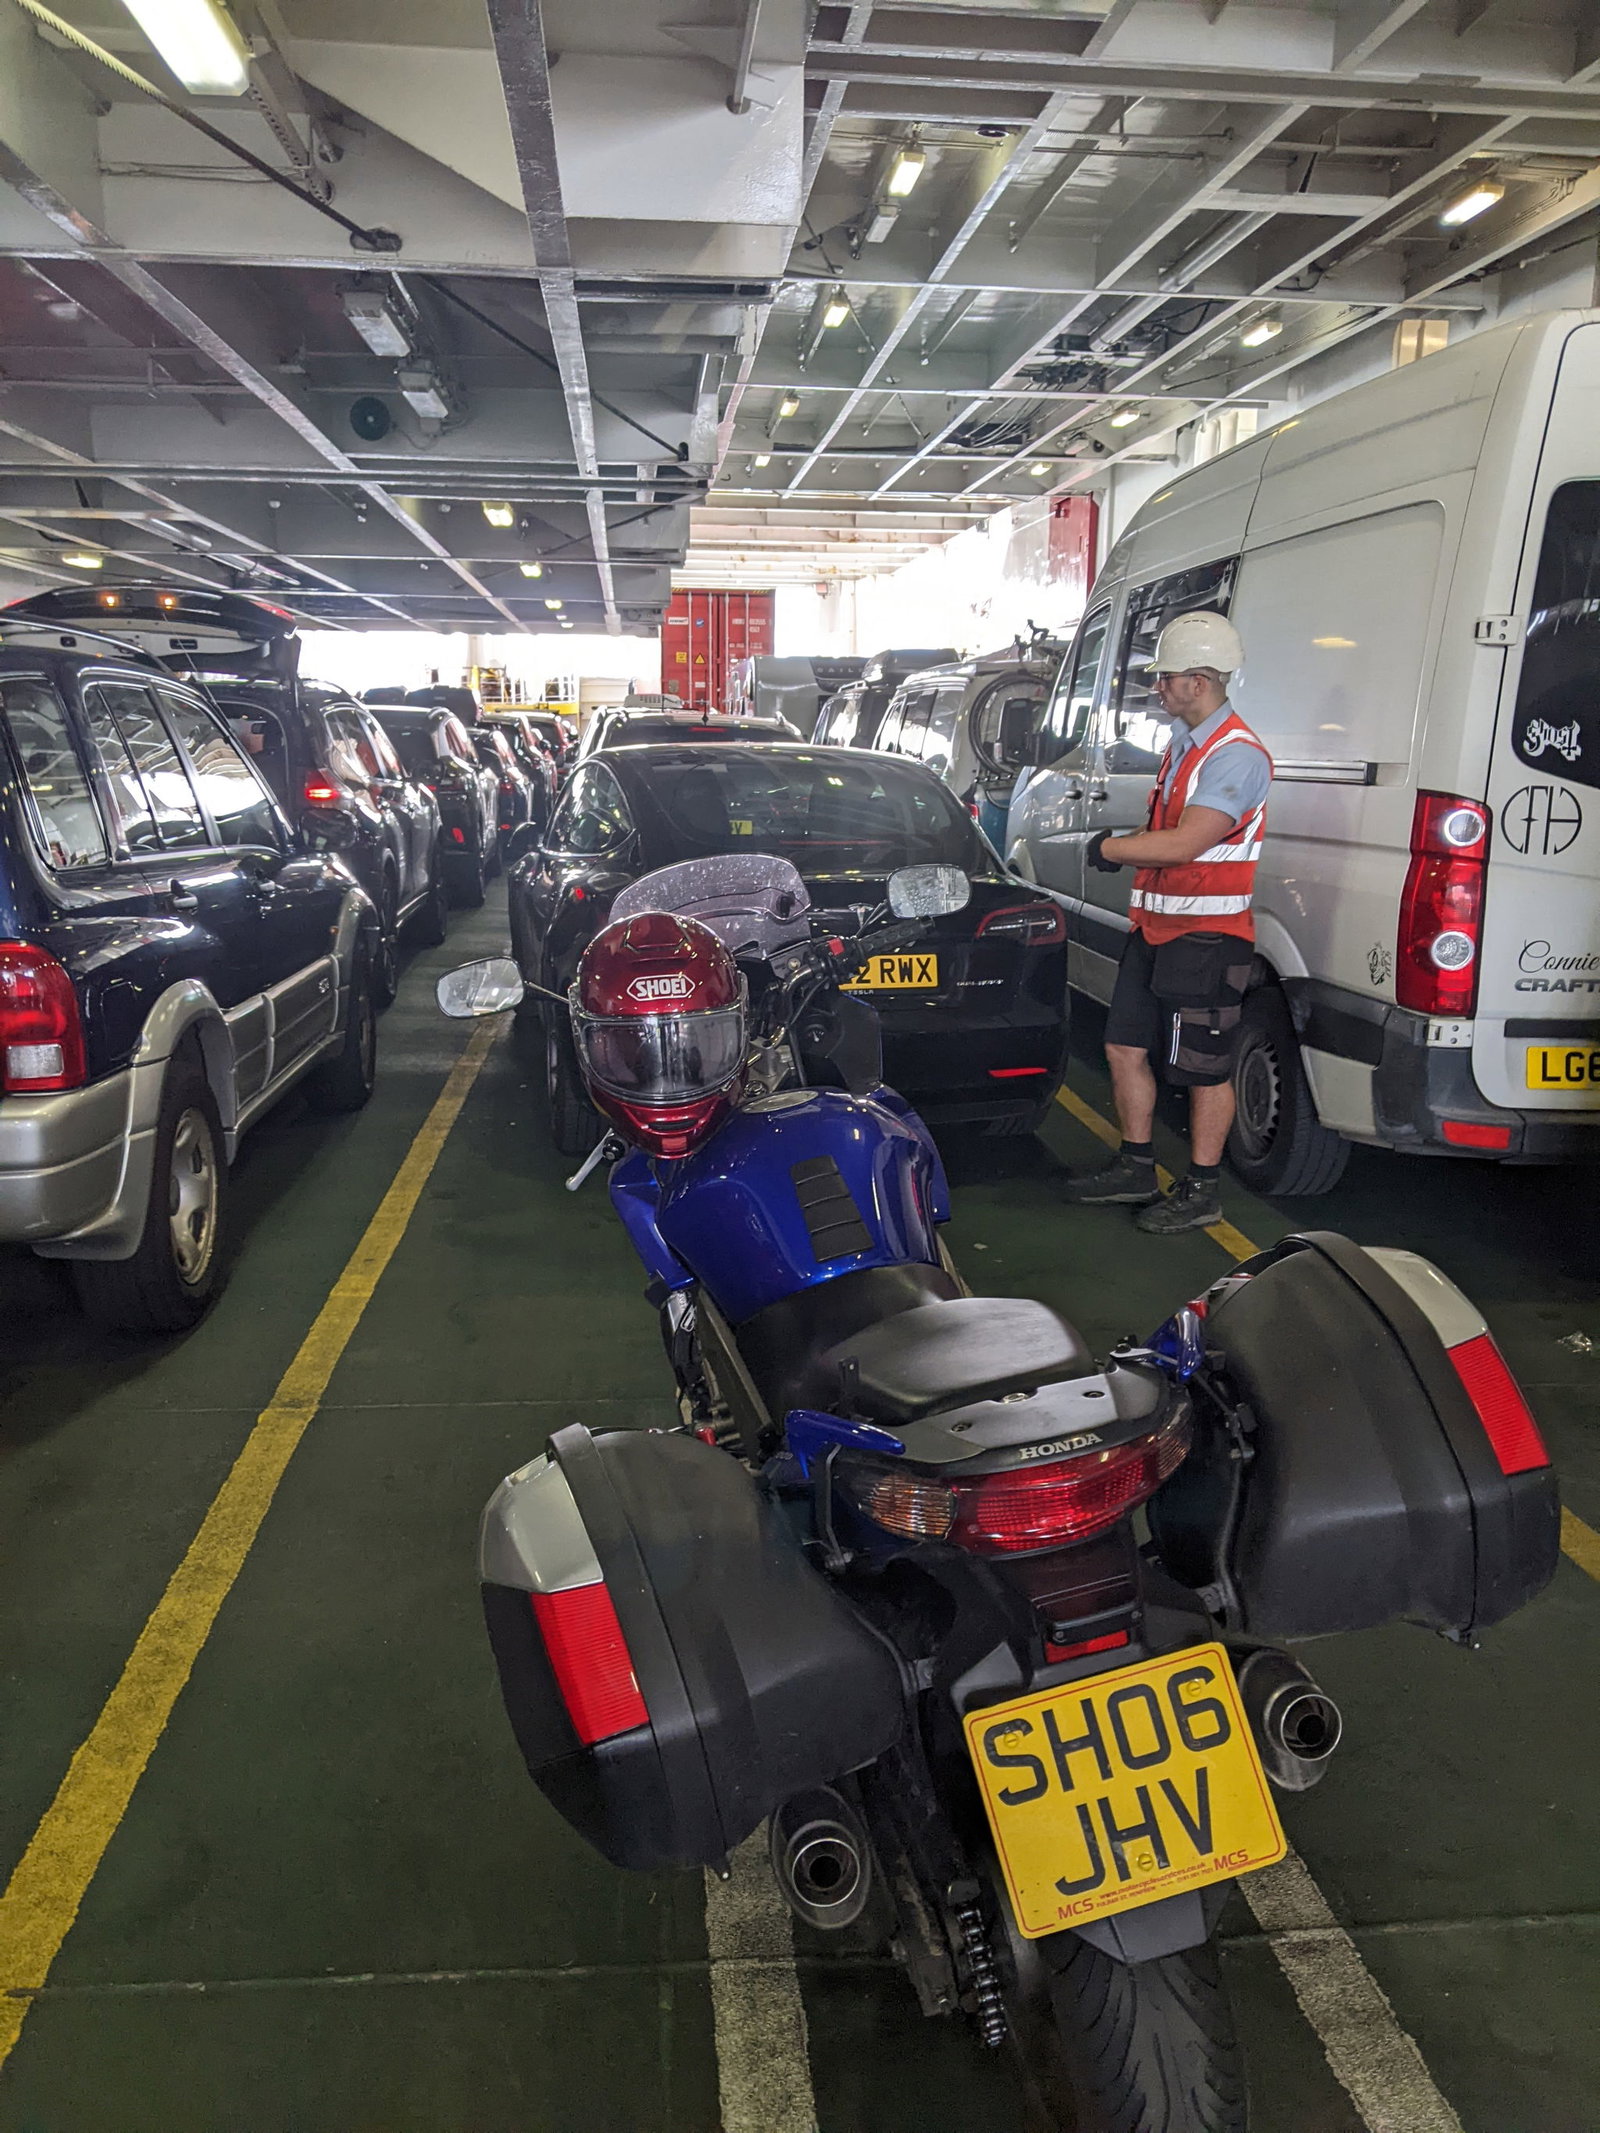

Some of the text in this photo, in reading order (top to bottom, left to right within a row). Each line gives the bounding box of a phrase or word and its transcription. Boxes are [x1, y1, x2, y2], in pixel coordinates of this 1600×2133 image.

[880, 957, 933, 985] RWX
[635, 978, 687, 998] SHOEI
[847, 988, 875, 996] TESLA
[1514, 977, 1600, 993] CRAFT
[1019, 1433, 1103, 1460] HONDA
[984, 1665, 1231, 1806] SH06
[1054, 1766, 1214, 1896] JHV
[1214, 1849, 1249, 1871] MCS
[1057, 1897, 1094, 1920] MCS
